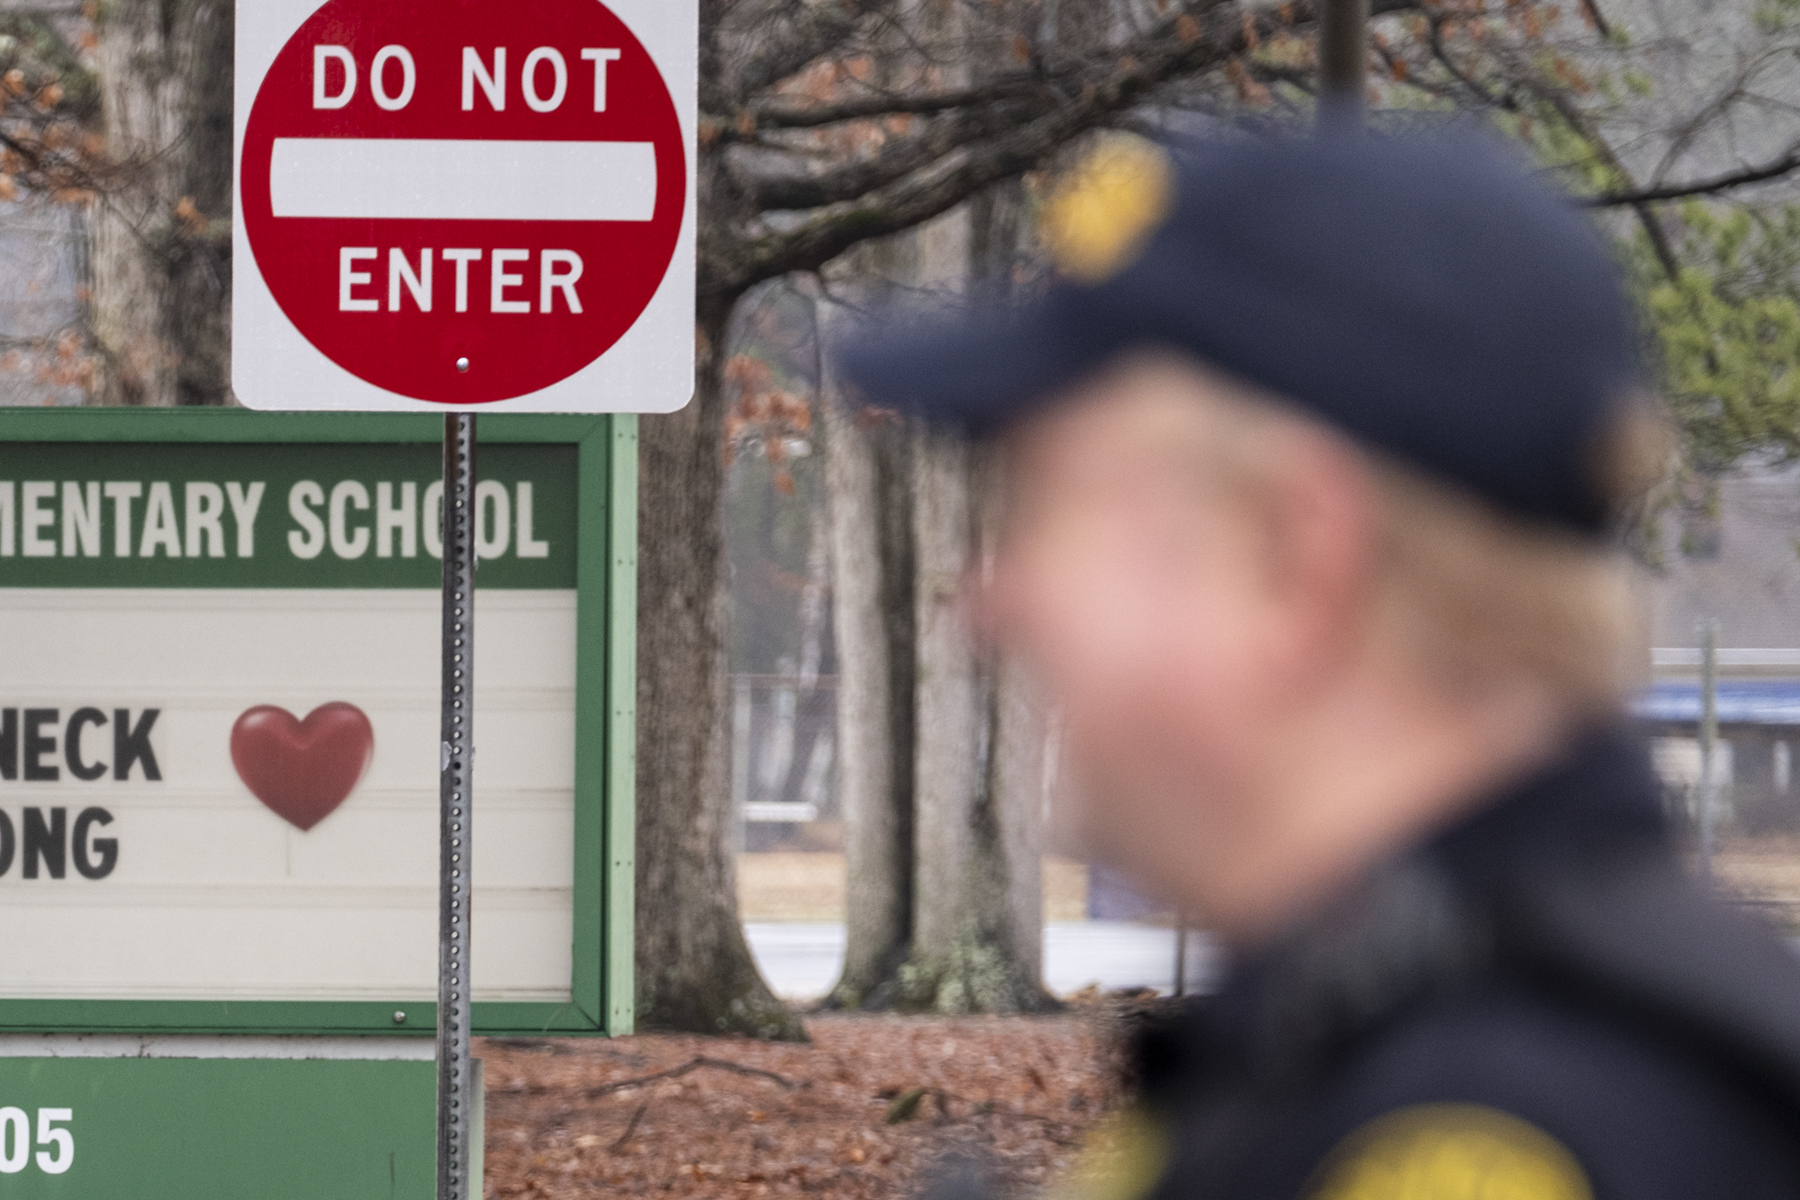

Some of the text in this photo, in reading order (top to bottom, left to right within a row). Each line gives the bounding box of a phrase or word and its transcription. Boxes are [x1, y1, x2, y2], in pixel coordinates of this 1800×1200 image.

[312, 44, 622, 113] DO NOT
[339, 246, 584, 314] ENTER
